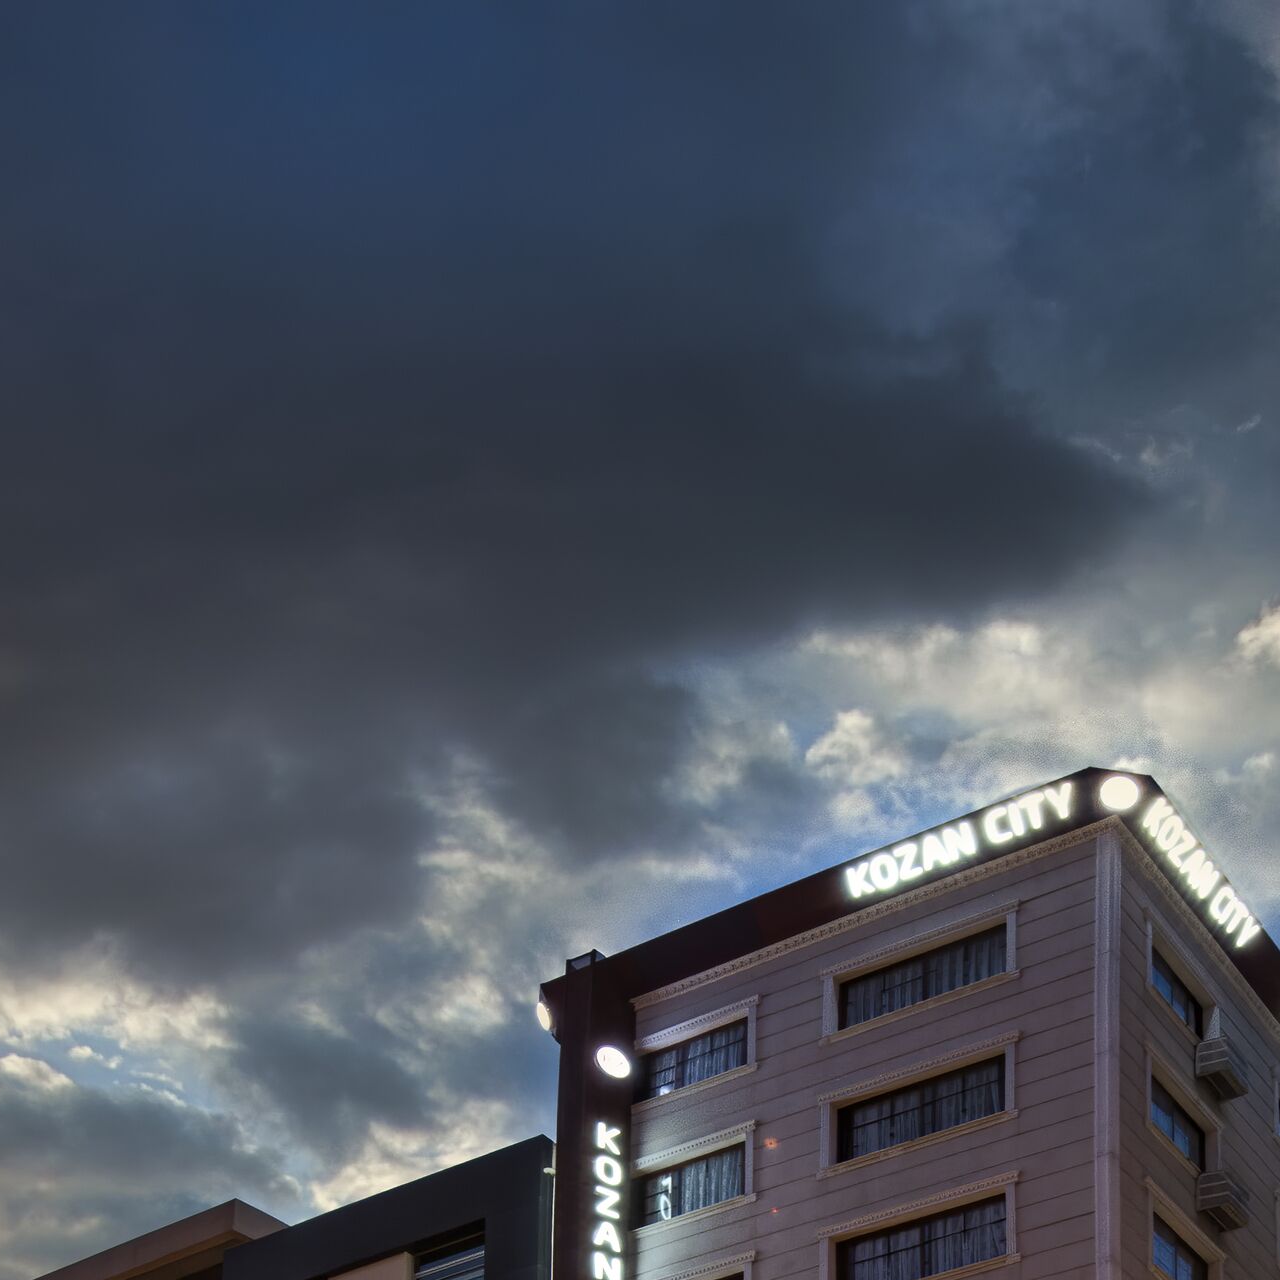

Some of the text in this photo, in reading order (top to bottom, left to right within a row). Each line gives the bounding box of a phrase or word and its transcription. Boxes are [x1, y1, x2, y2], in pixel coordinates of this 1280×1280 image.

[845, 782, 1072, 898] KOZAN CITY
[1142, 797, 1261, 948] KOZAN CITY
